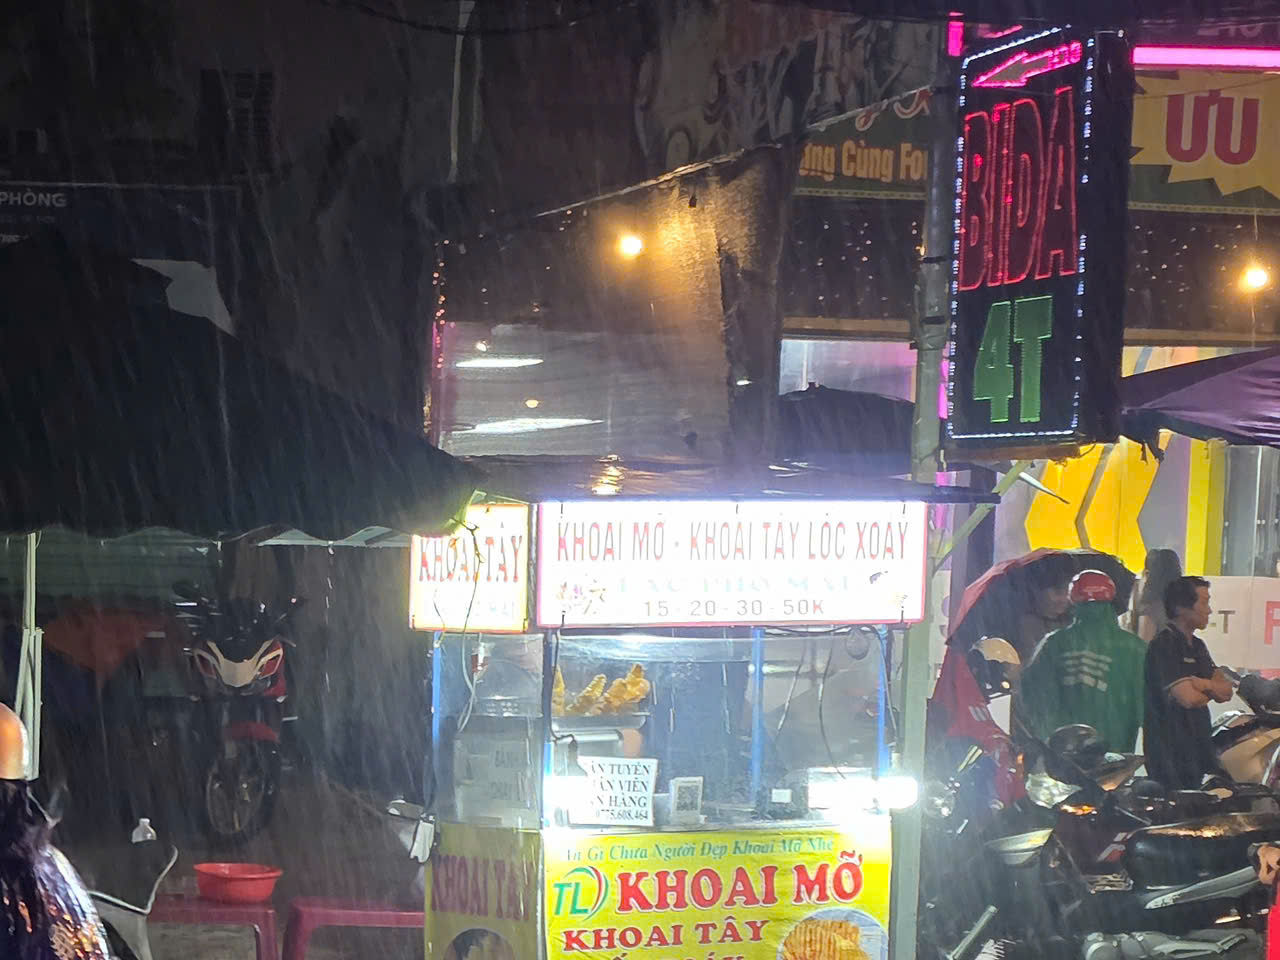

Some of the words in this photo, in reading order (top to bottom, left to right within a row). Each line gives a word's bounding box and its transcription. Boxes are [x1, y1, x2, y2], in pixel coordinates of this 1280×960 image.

[842, 138, 894, 183] Cùng
[958, 86, 1077, 291] BIDA
[972, 295, 1053, 423] 4T
[557, 520, 623, 561] KHOAI
[690, 520, 753, 561] KHOAI
[732, 839, 775, 855] Khoai
[553, 881, 590, 915] TL
[615, 864, 780, 914] KHOAI
[563, 923, 684, 952] KHOAI
[694, 915, 769, 945] TÂY
